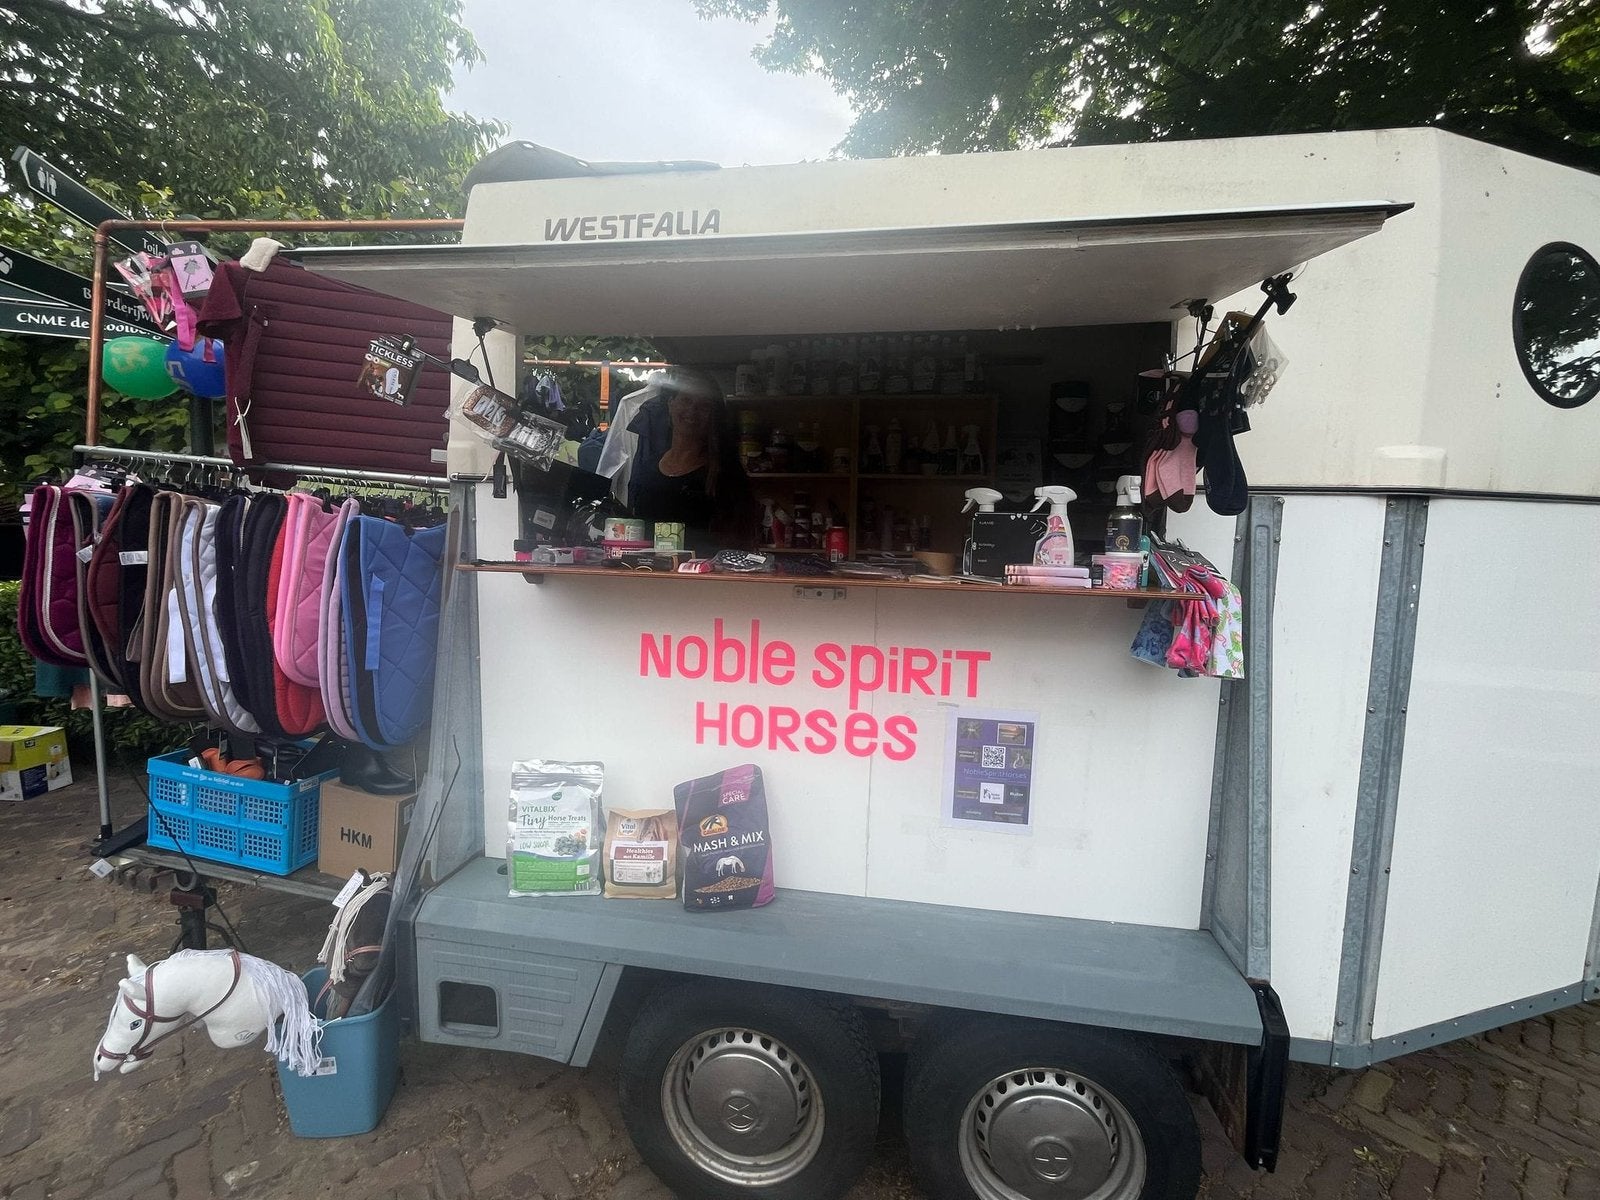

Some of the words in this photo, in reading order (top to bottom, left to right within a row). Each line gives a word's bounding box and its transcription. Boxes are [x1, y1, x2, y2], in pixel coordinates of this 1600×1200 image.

[544, 208, 721, 242] WESTFALIA
[16, 312, 67, 327] CNME
[70, 316, 89, 329] de
[369, 343, 414, 368] TICKLESS
[722, 789, 744, 797] SPECIAL
[722, 794, 746, 805] CARE
[522, 805, 556, 813] VITALBIX
[520, 814, 547, 830] Tiny
[340, 826, 373, 850] HKM
[693, 837, 728, 853] MASH
[730, 836, 739, 847] &
[741, 831, 764, 845] MIX
